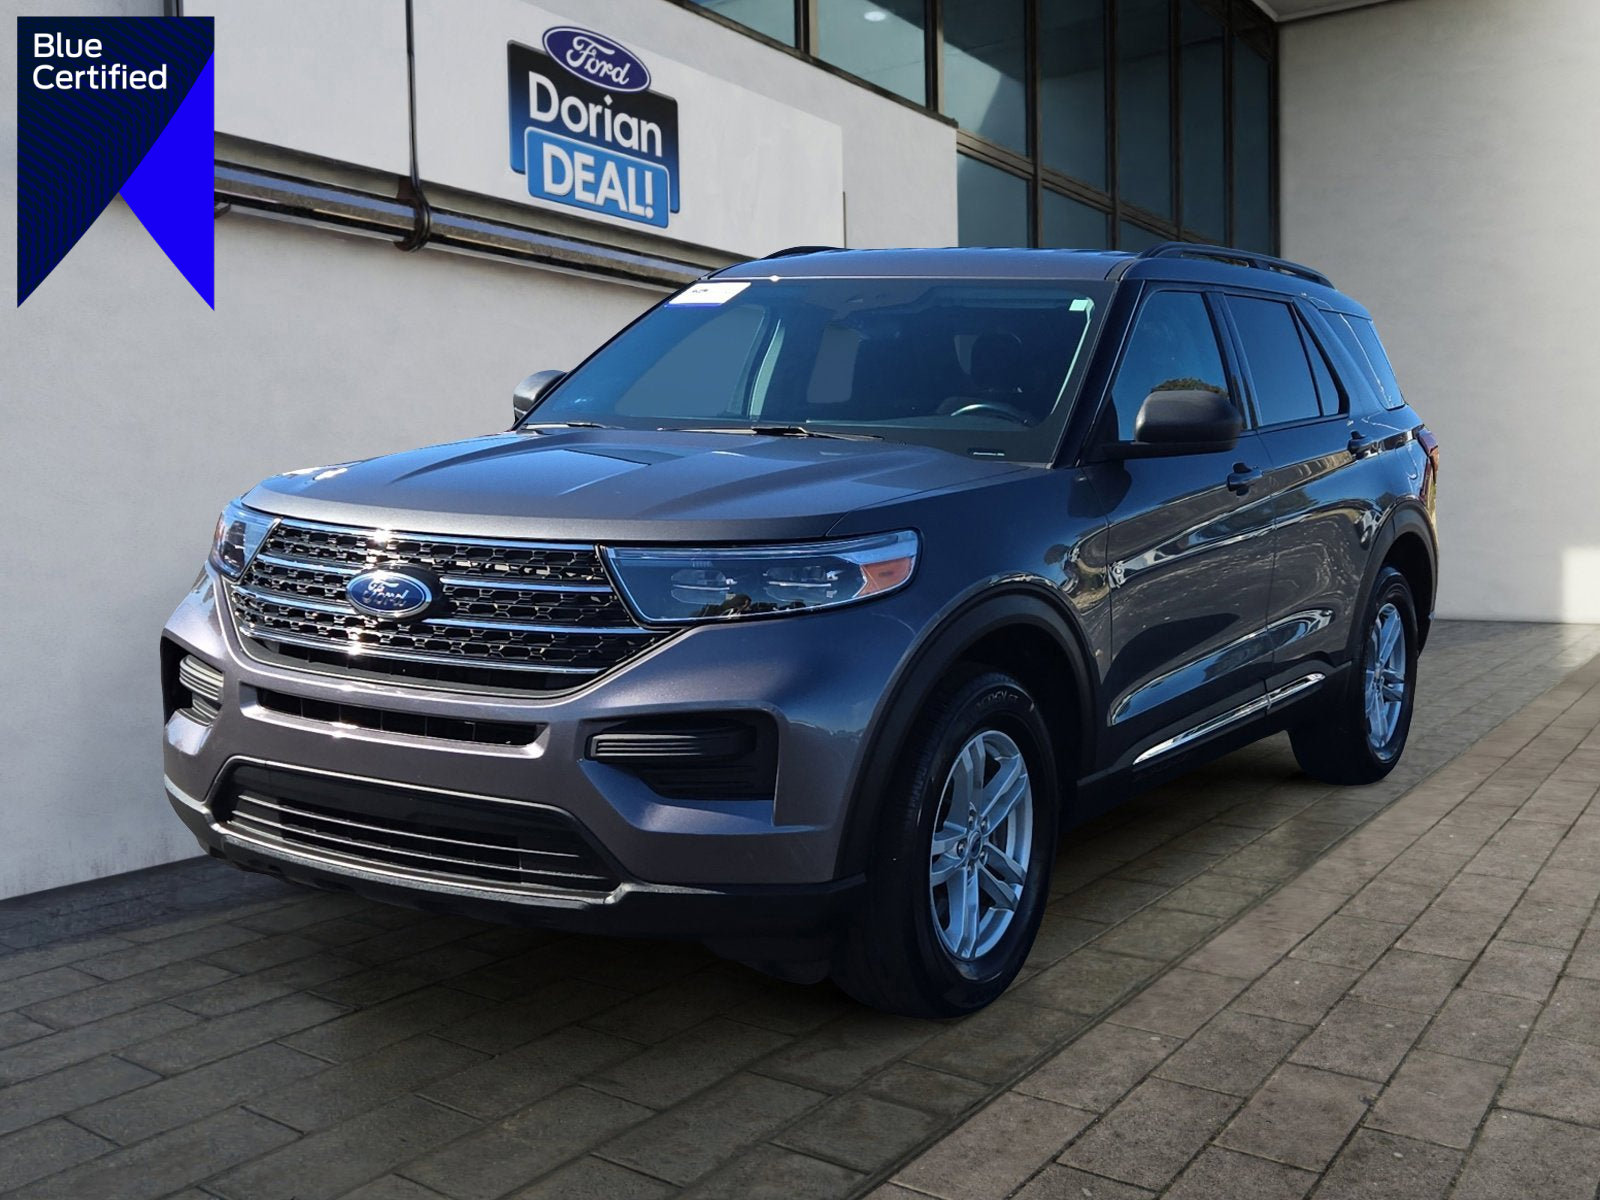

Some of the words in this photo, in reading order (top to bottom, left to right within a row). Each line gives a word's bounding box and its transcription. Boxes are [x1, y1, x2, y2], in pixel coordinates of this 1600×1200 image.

[566, 36, 631, 85] Ford
[529, 71, 662, 157] Dorian
[543, 142, 654, 219] DEAL!
[363, 579, 409, 607] Ford
